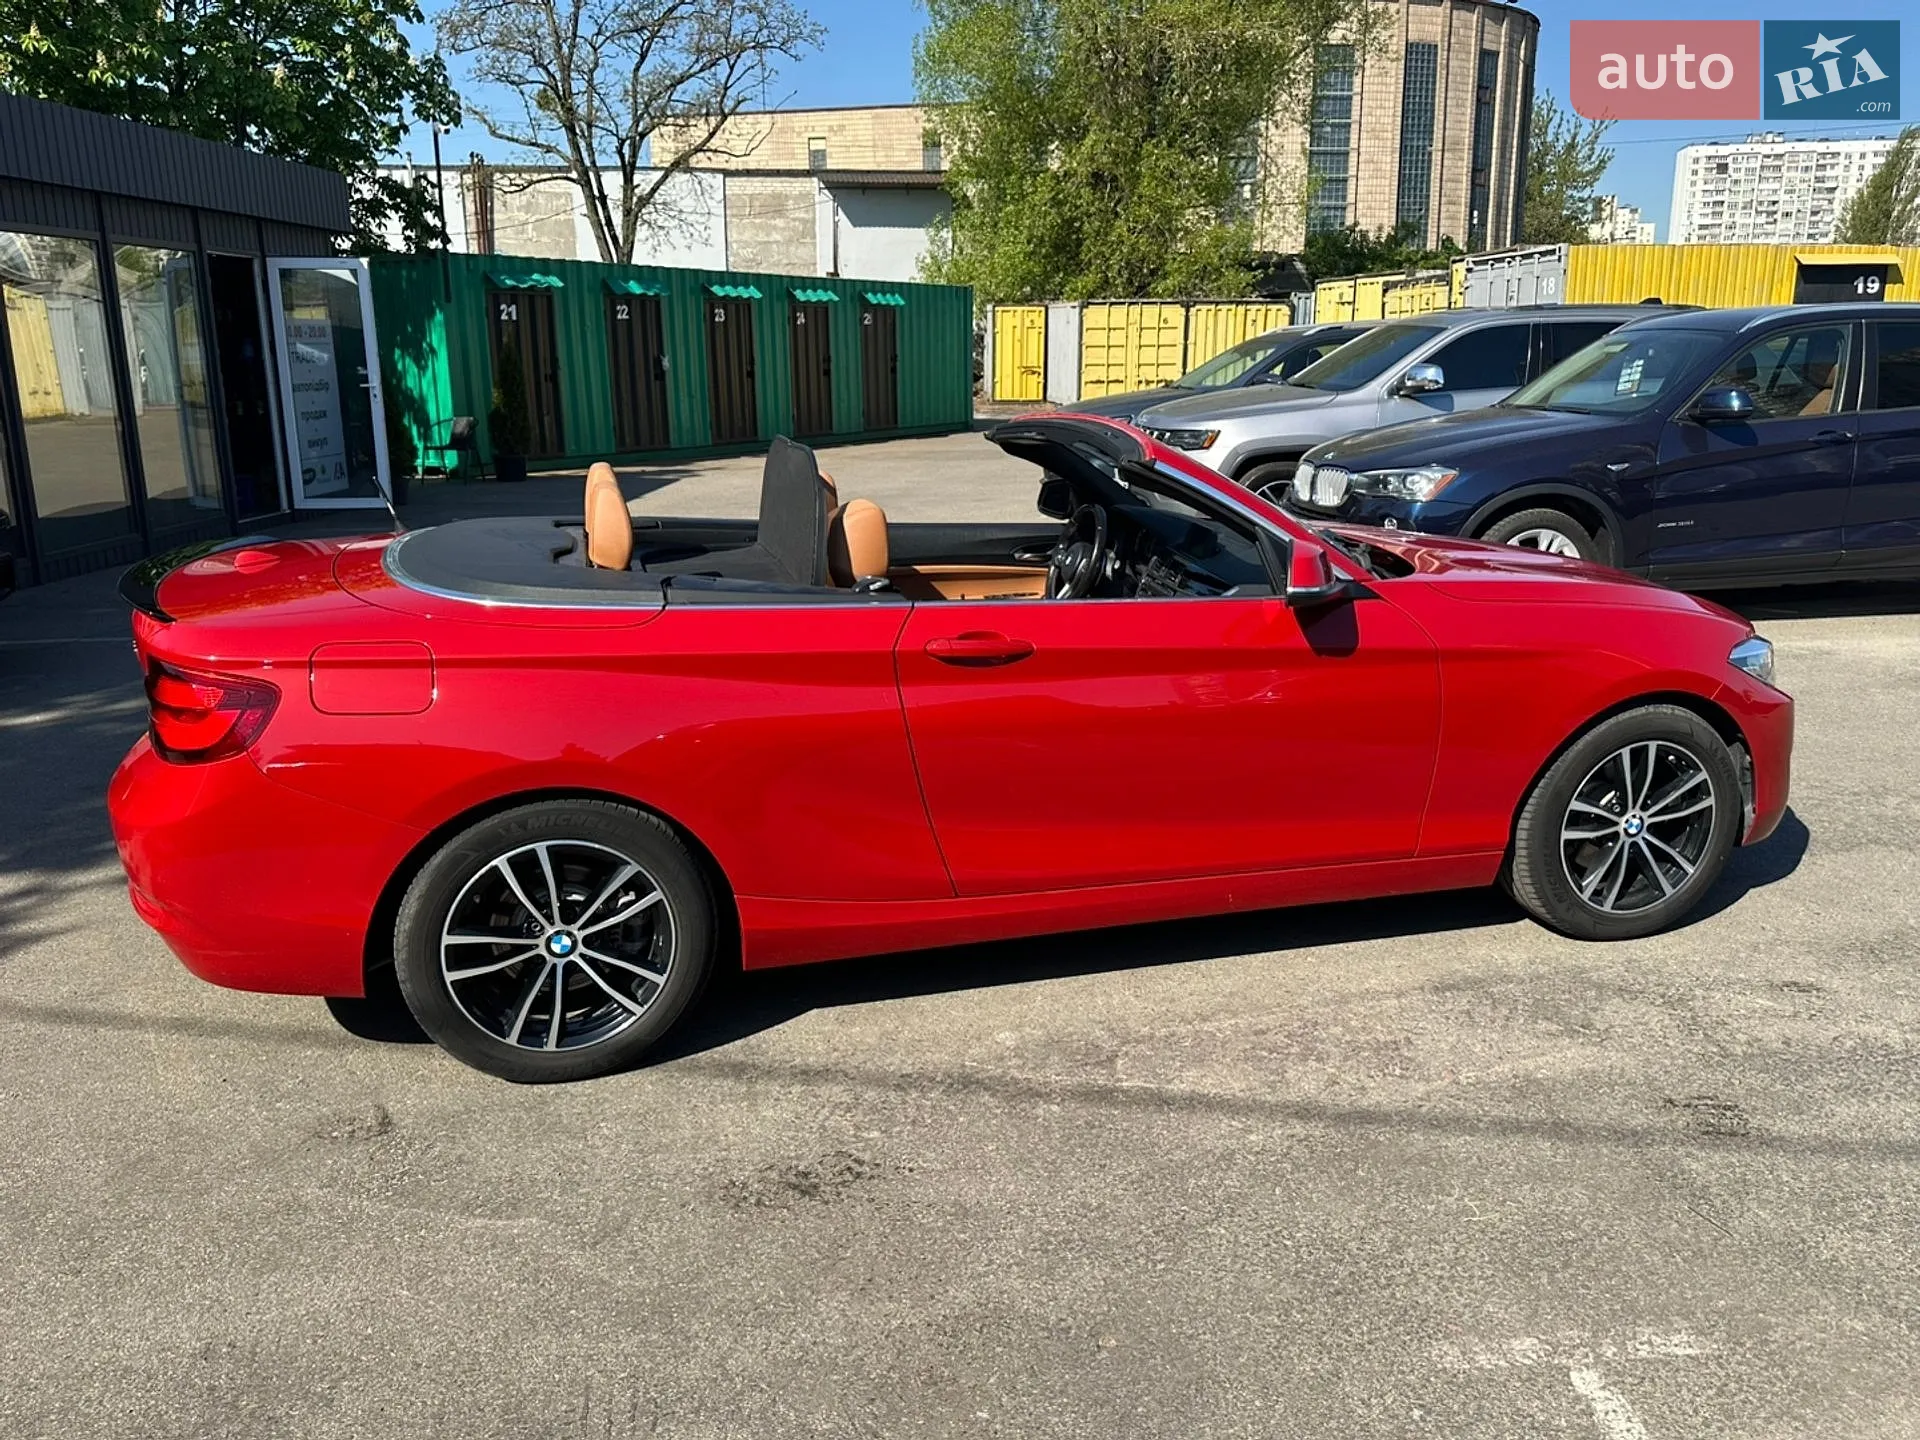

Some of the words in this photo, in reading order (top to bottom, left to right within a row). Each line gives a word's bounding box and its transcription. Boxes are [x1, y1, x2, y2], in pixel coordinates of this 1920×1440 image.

[1541, 277, 1556, 295] 18
[1853, 276, 1880, 294] 19
[500, 304, 517, 320] 21
[616, 305, 629, 319] 22
[714, 308, 725, 322] 23
